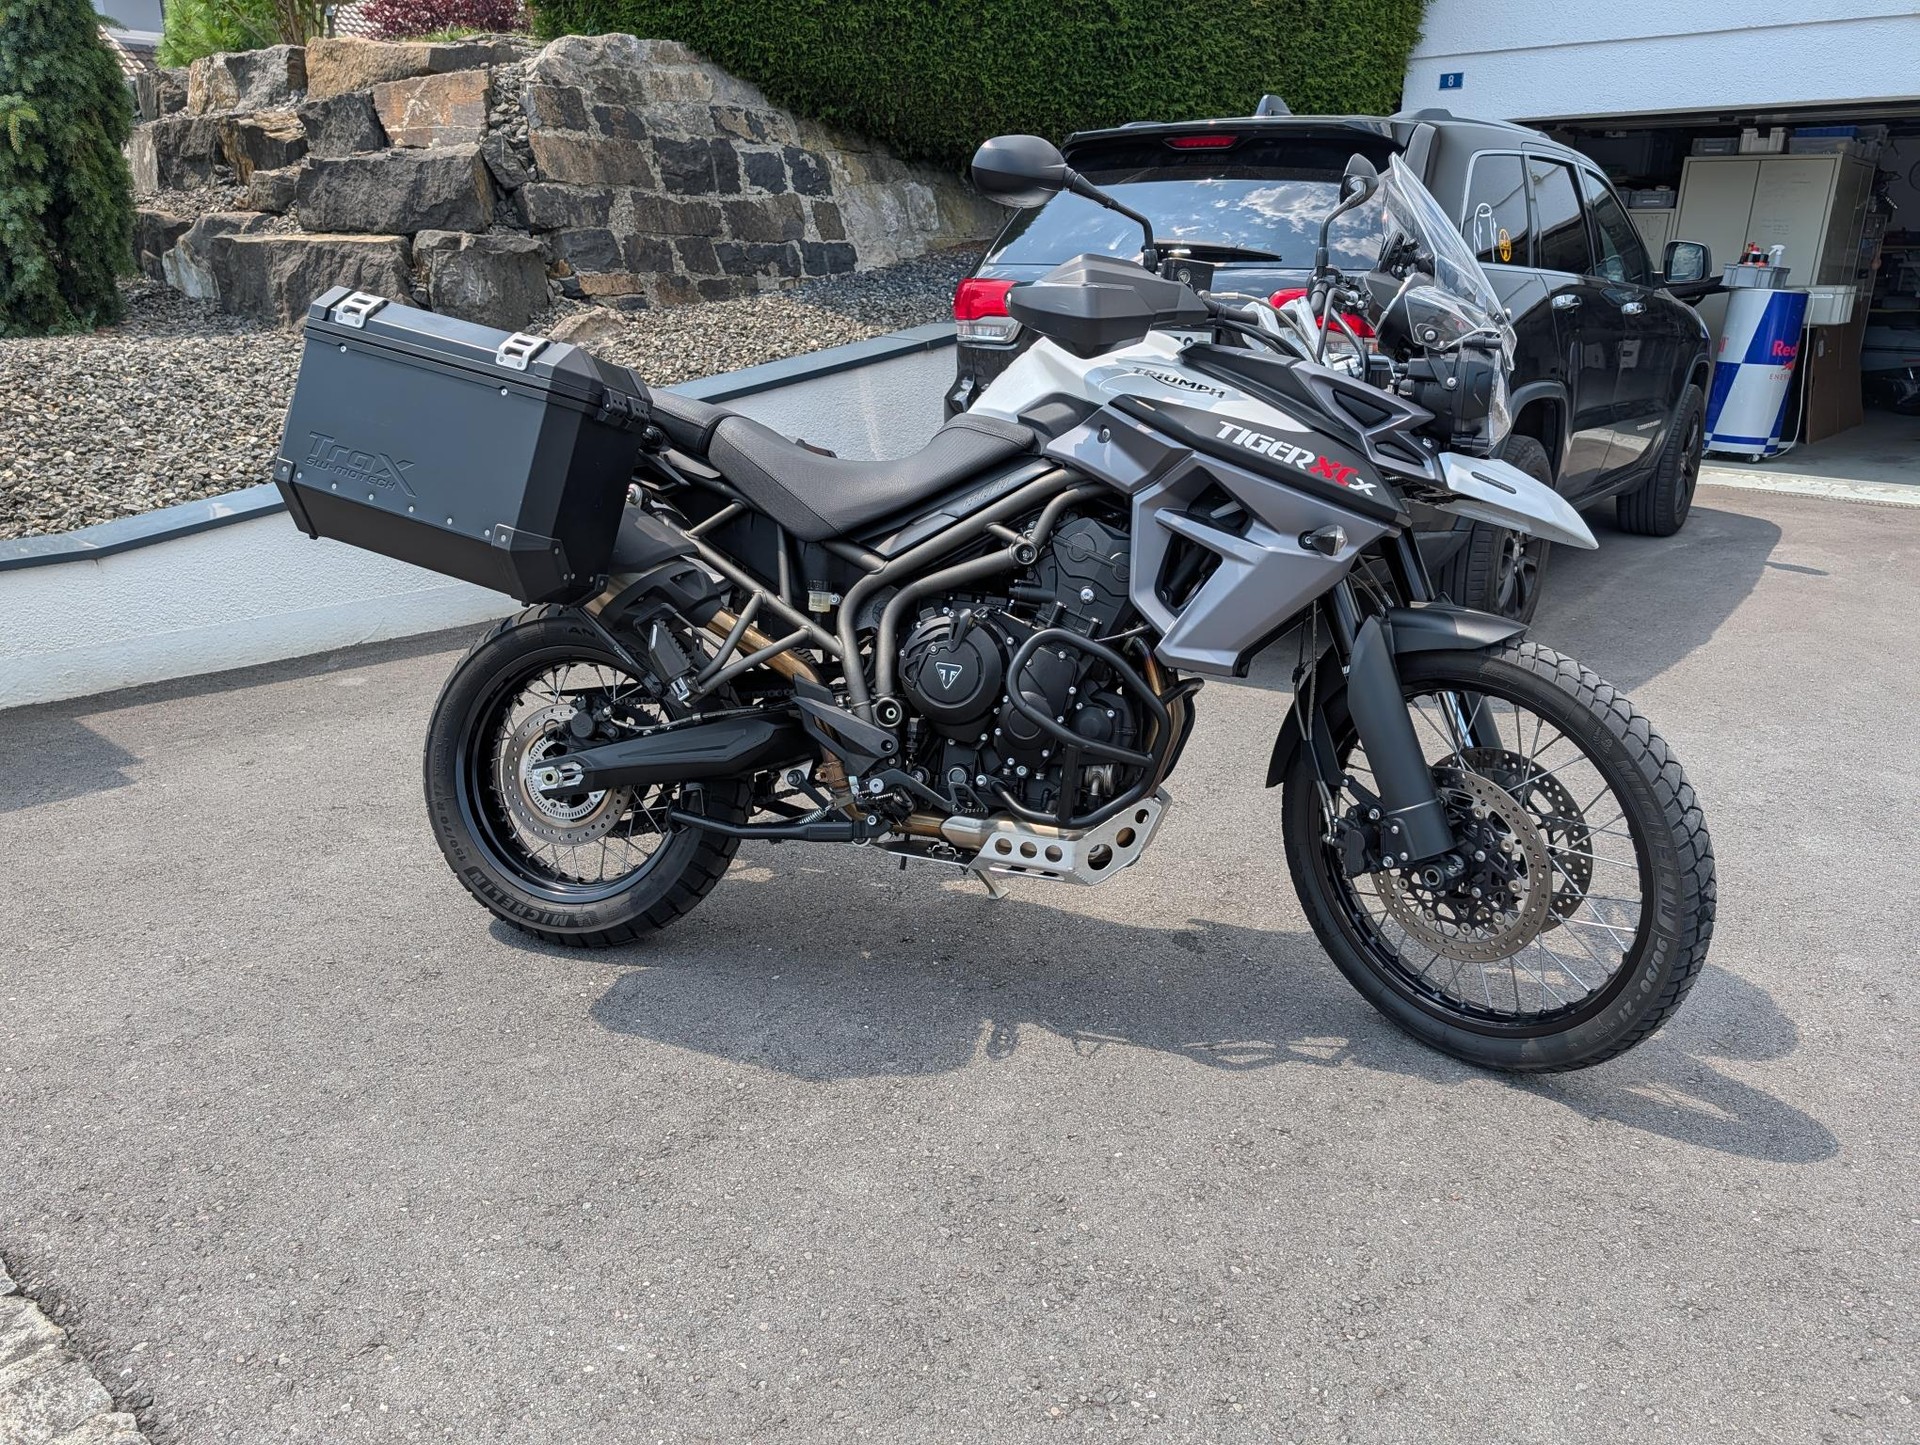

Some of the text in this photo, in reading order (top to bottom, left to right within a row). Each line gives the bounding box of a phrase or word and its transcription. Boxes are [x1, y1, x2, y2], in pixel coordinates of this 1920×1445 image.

[1447, 74, 1454, 87] 8
[1133, 366, 1225, 399] TRIUMPH
[1216, 420, 1316, 470] TIGER
[306, 457, 396, 491] SW-MOTECH
[1615, 759, 1678, 934] MICHELIN
[469, 871, 570, 927] MICHELIN
[1640, 937, 1668, 994] 90/90
[1618, 1001, 1636, 1021] 21
